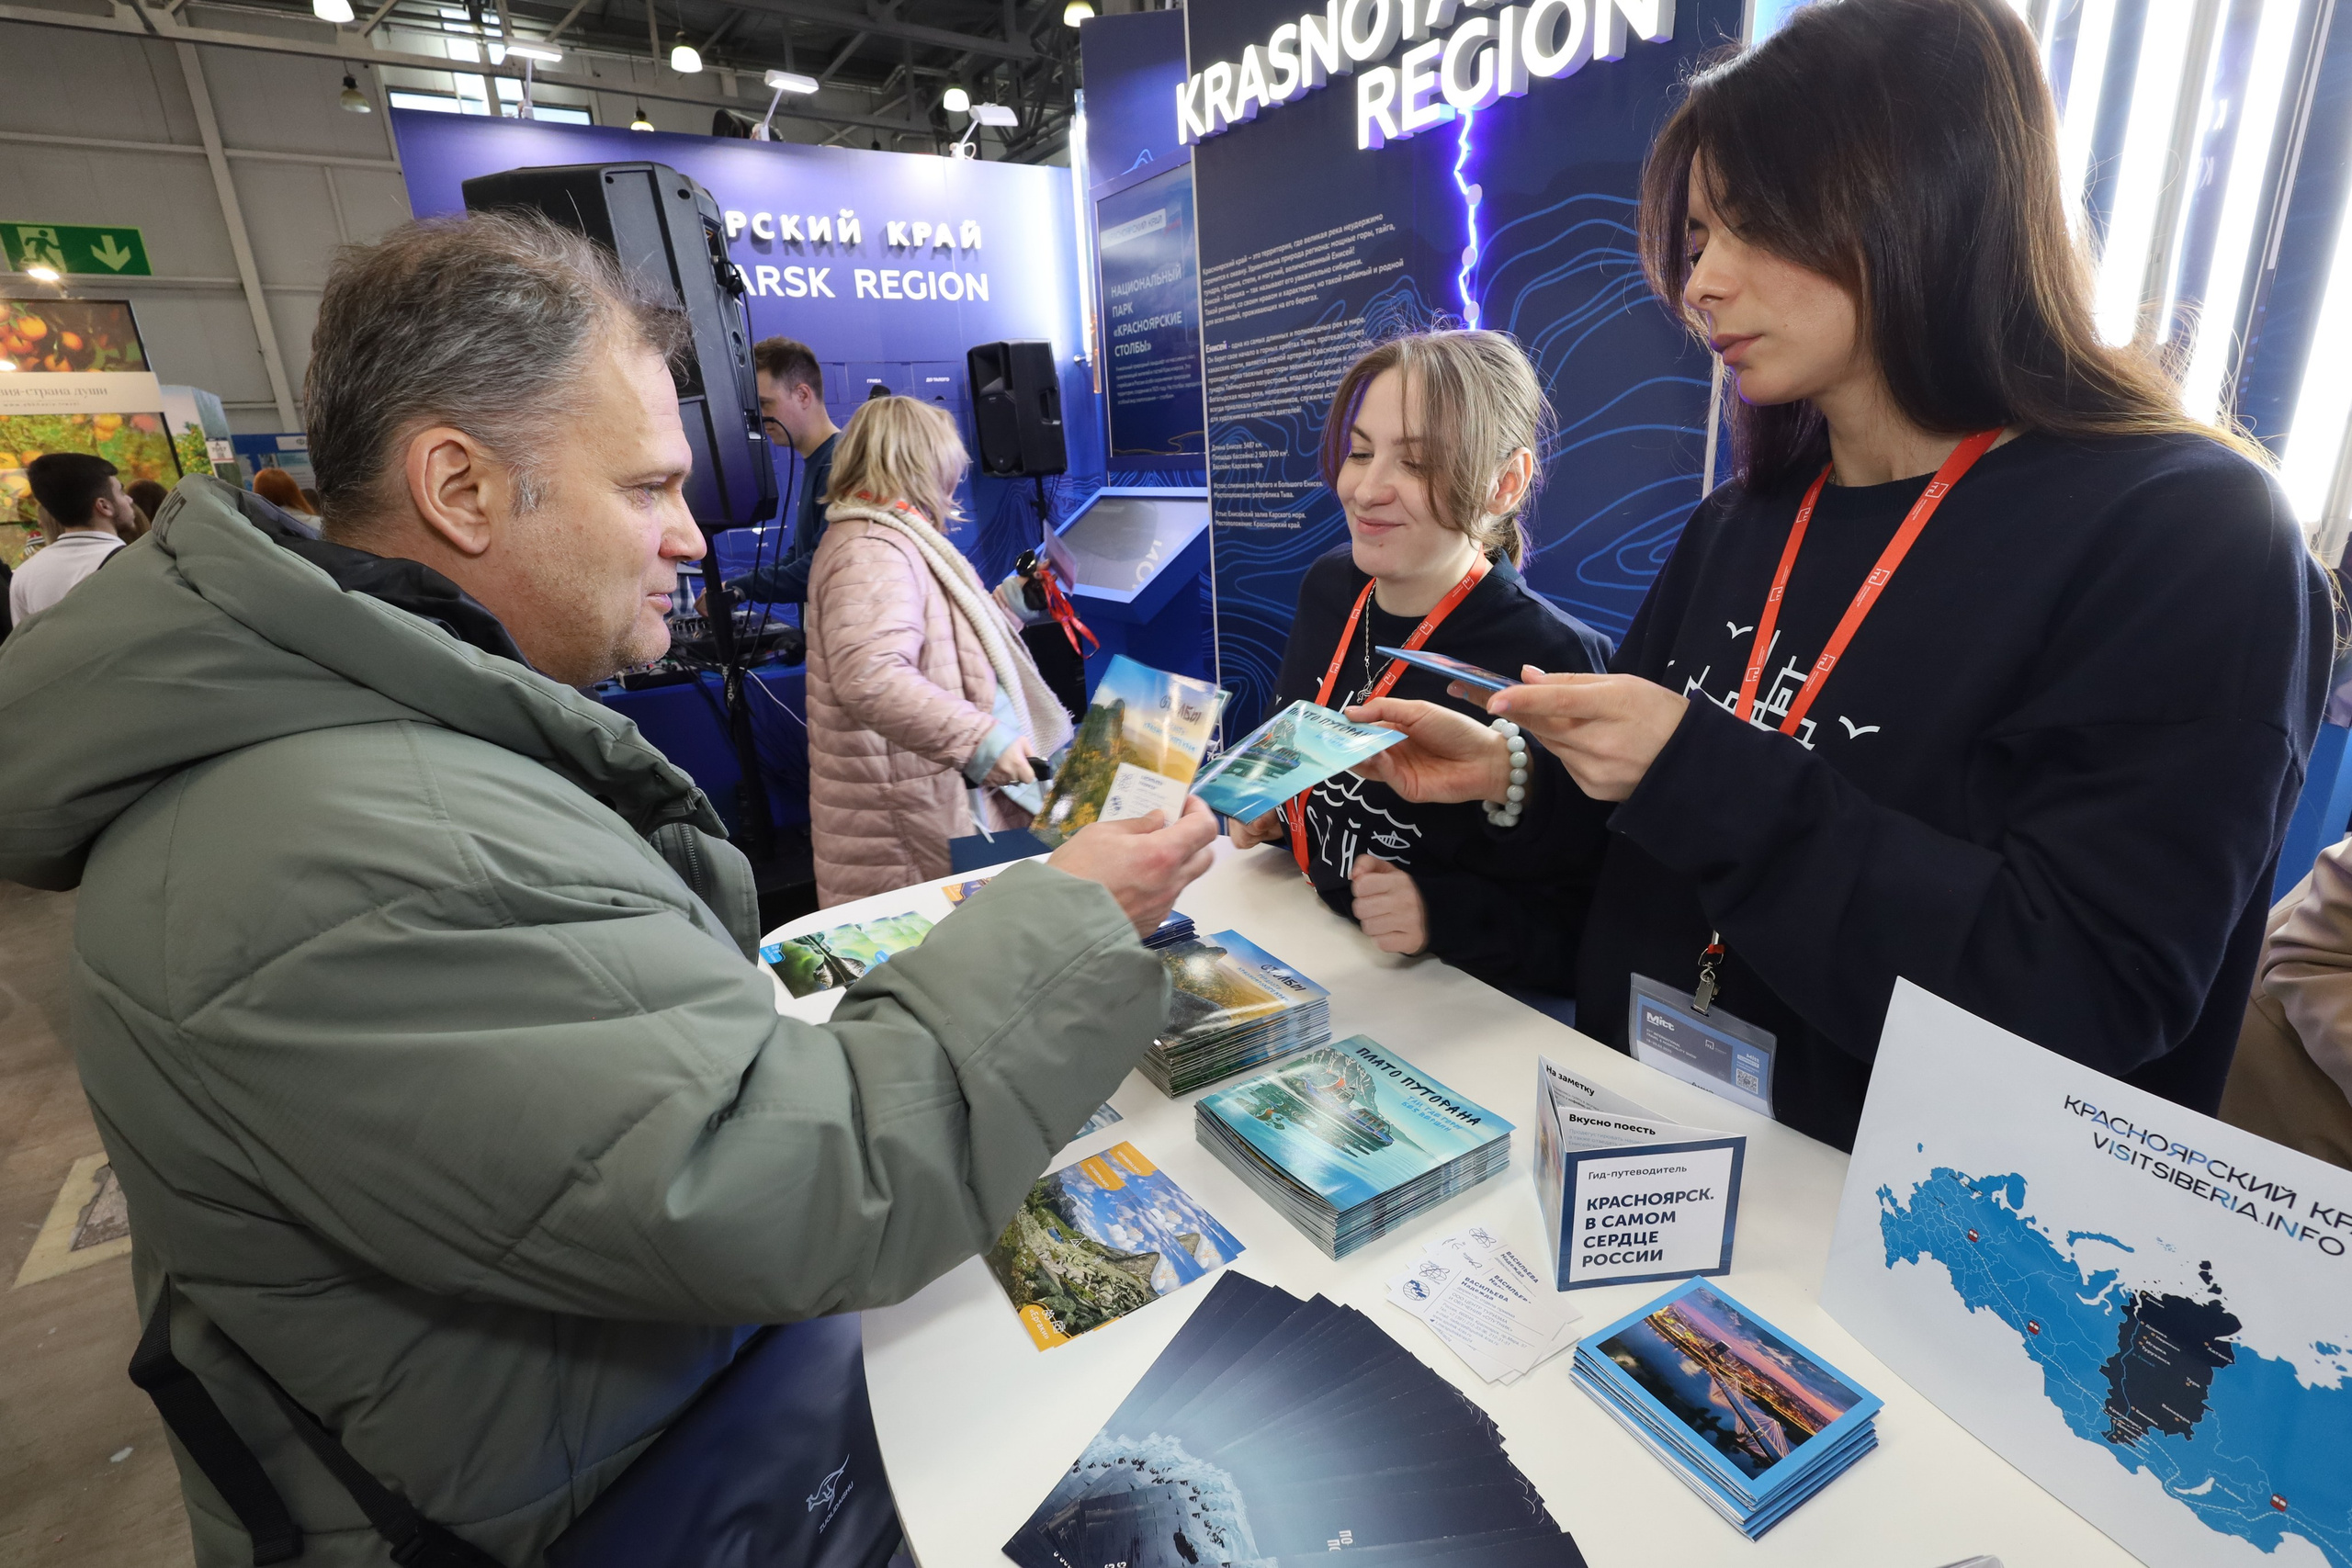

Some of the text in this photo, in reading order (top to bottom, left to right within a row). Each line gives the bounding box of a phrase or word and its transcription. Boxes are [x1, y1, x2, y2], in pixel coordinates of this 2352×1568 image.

[1175, 0, 1481, 146] KRASNOY
[1358, 0, 1676, 150] REGION
[724, 208, 982, 250] РСКИЙ КРАЙ
[1329, 226, 1341, 238] река
[1343, 214, 1383, 231] неудержимо
[1330, 235, 1355, 247] мощные
[1356, 230, 1374, 240] горы,
[1374, 223, 1395, 234] тайга,
[1331, 246, 1354, 259] Енисей!
[1378, 258, 1403, 274] родной
[732, 264, 989, 301] ARSK REGION
[1112, 264, 1182, 298] НАЦИОНАЛЬНЫЙ
[1112, 301, 1134, 318] ПАРК
[1114, 310, 1182, 338] «КРАСНОЯРСКИЕ
[1114, 340, 1152, 357] СТОЛБЫ»
[1205, 342, 1227, 353] Енисей
[1646, 1011, 1675, 1031] Mitt
[1356, 1047, 1481, 1126] ПЛАТО ПУТОРАНА
[1545, 1064, 1595, 1097] На заметку
[1569, 1113, 1656, 1135] Вкусно поесть
[1588, 1166, 1687, 1180] Гид-путеводитель
[2064, 1095, 2352, 1235] КРАСНОЯРСКИЙ КР
[1586, 1188, 1714, 1211] КРАСНОЯРСК.
[2093, 1132, 2345, 1257] VISITSIBERIA.INFO
[1586, 1211, 1676, 1230] В САМОМ
[1584, 1231, 1659, 1249] СЕРДЦЕ
[1500, 1253, 1525, 1278] Надежда
[1506, 1251, 1539, 1283] ВАСИЛЬЕВА
[1582, 1249, 1663, 1268] РОССИИ
[1461, 1280, 1494, 1301] Надежда
[1464, 1277, 1509, 1302] ВАСИЛЬЕВА
[1029, 1309, 1050, 1340] «Ергаки»
[1484, 1308, 1507, 1324] ТУРИЗМА
